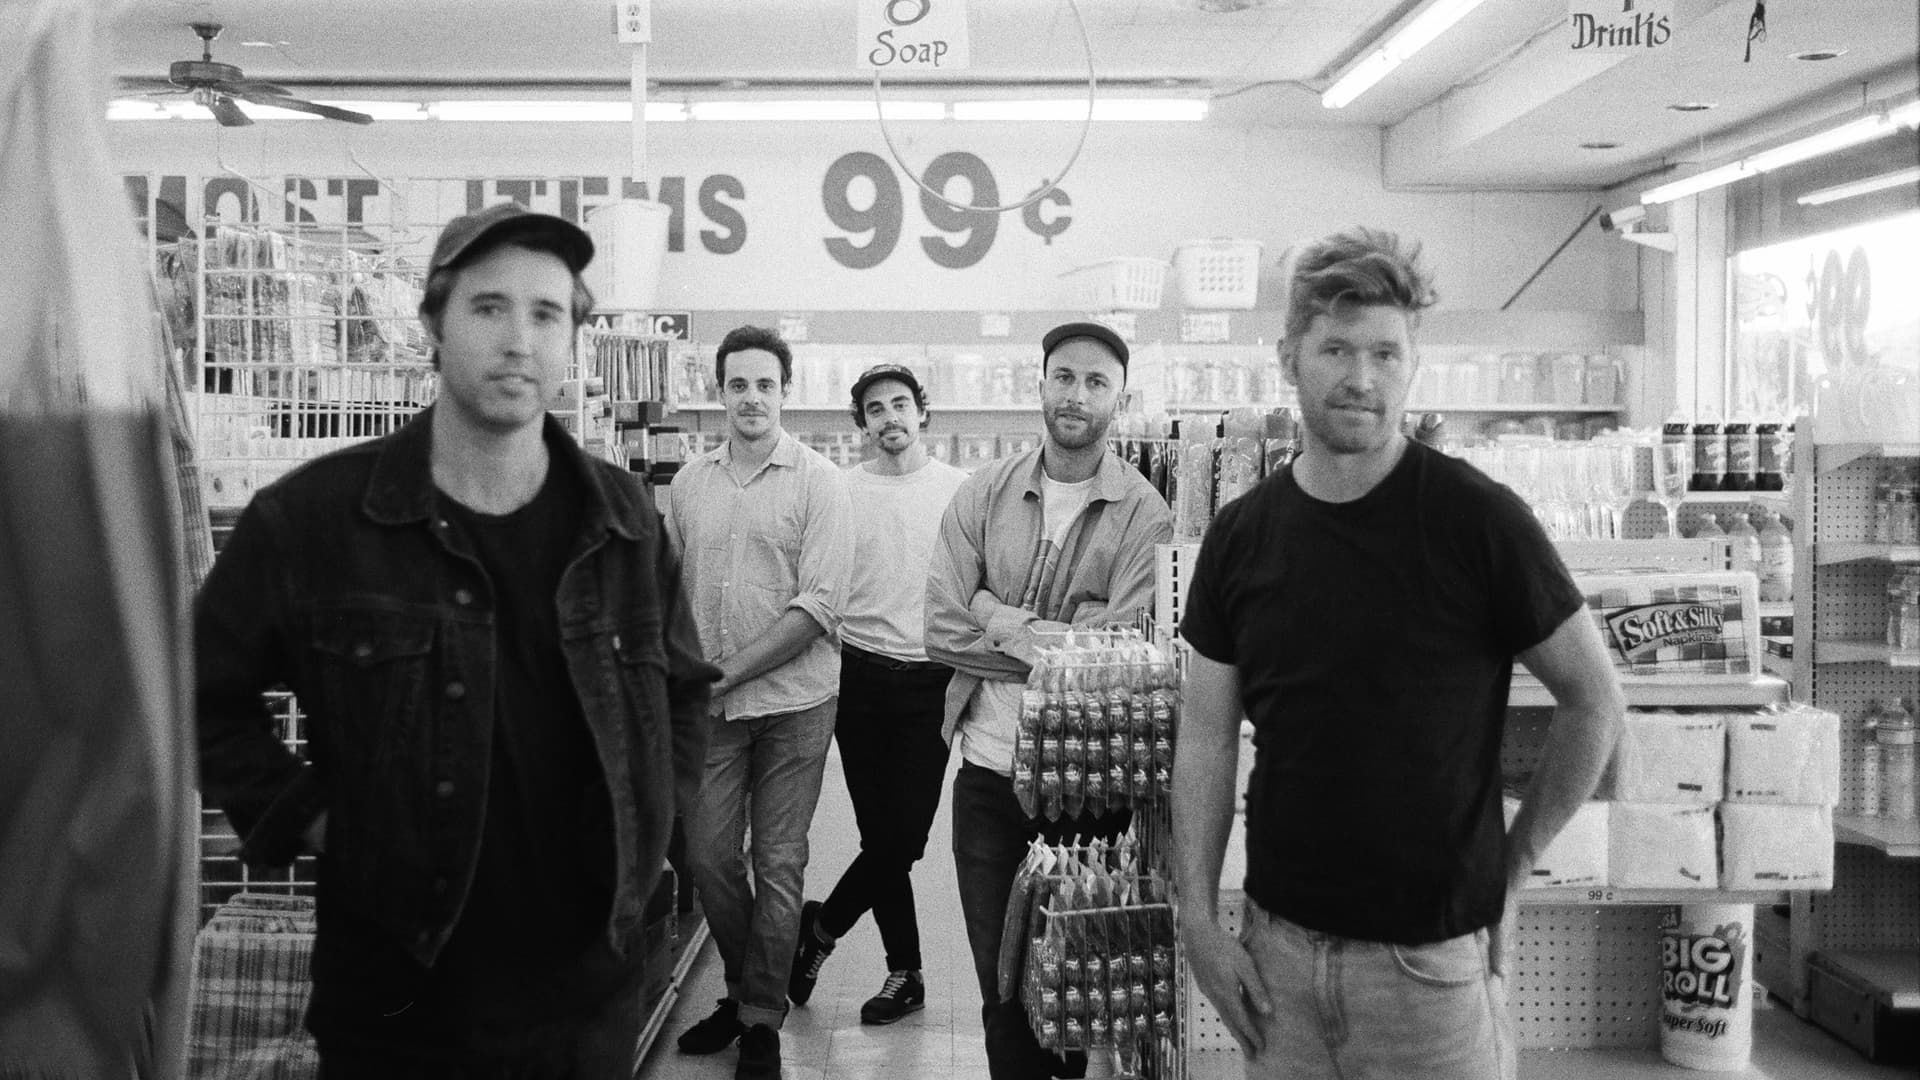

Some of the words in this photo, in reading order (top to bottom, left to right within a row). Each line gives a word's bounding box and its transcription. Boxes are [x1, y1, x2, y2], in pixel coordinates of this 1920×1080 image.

[1571, 12, 1671, 49] Drinks
[868, 29, 948, 67] Soap
[1662, 631, 1713, 648] Napkins
[1588, 890, 1602, 900] 99
[1662, 936, 1732, 973] BIG
[1663, 970, 1731, 1003] ROLL
[1696, 1014, 1727, 1038] Soft
